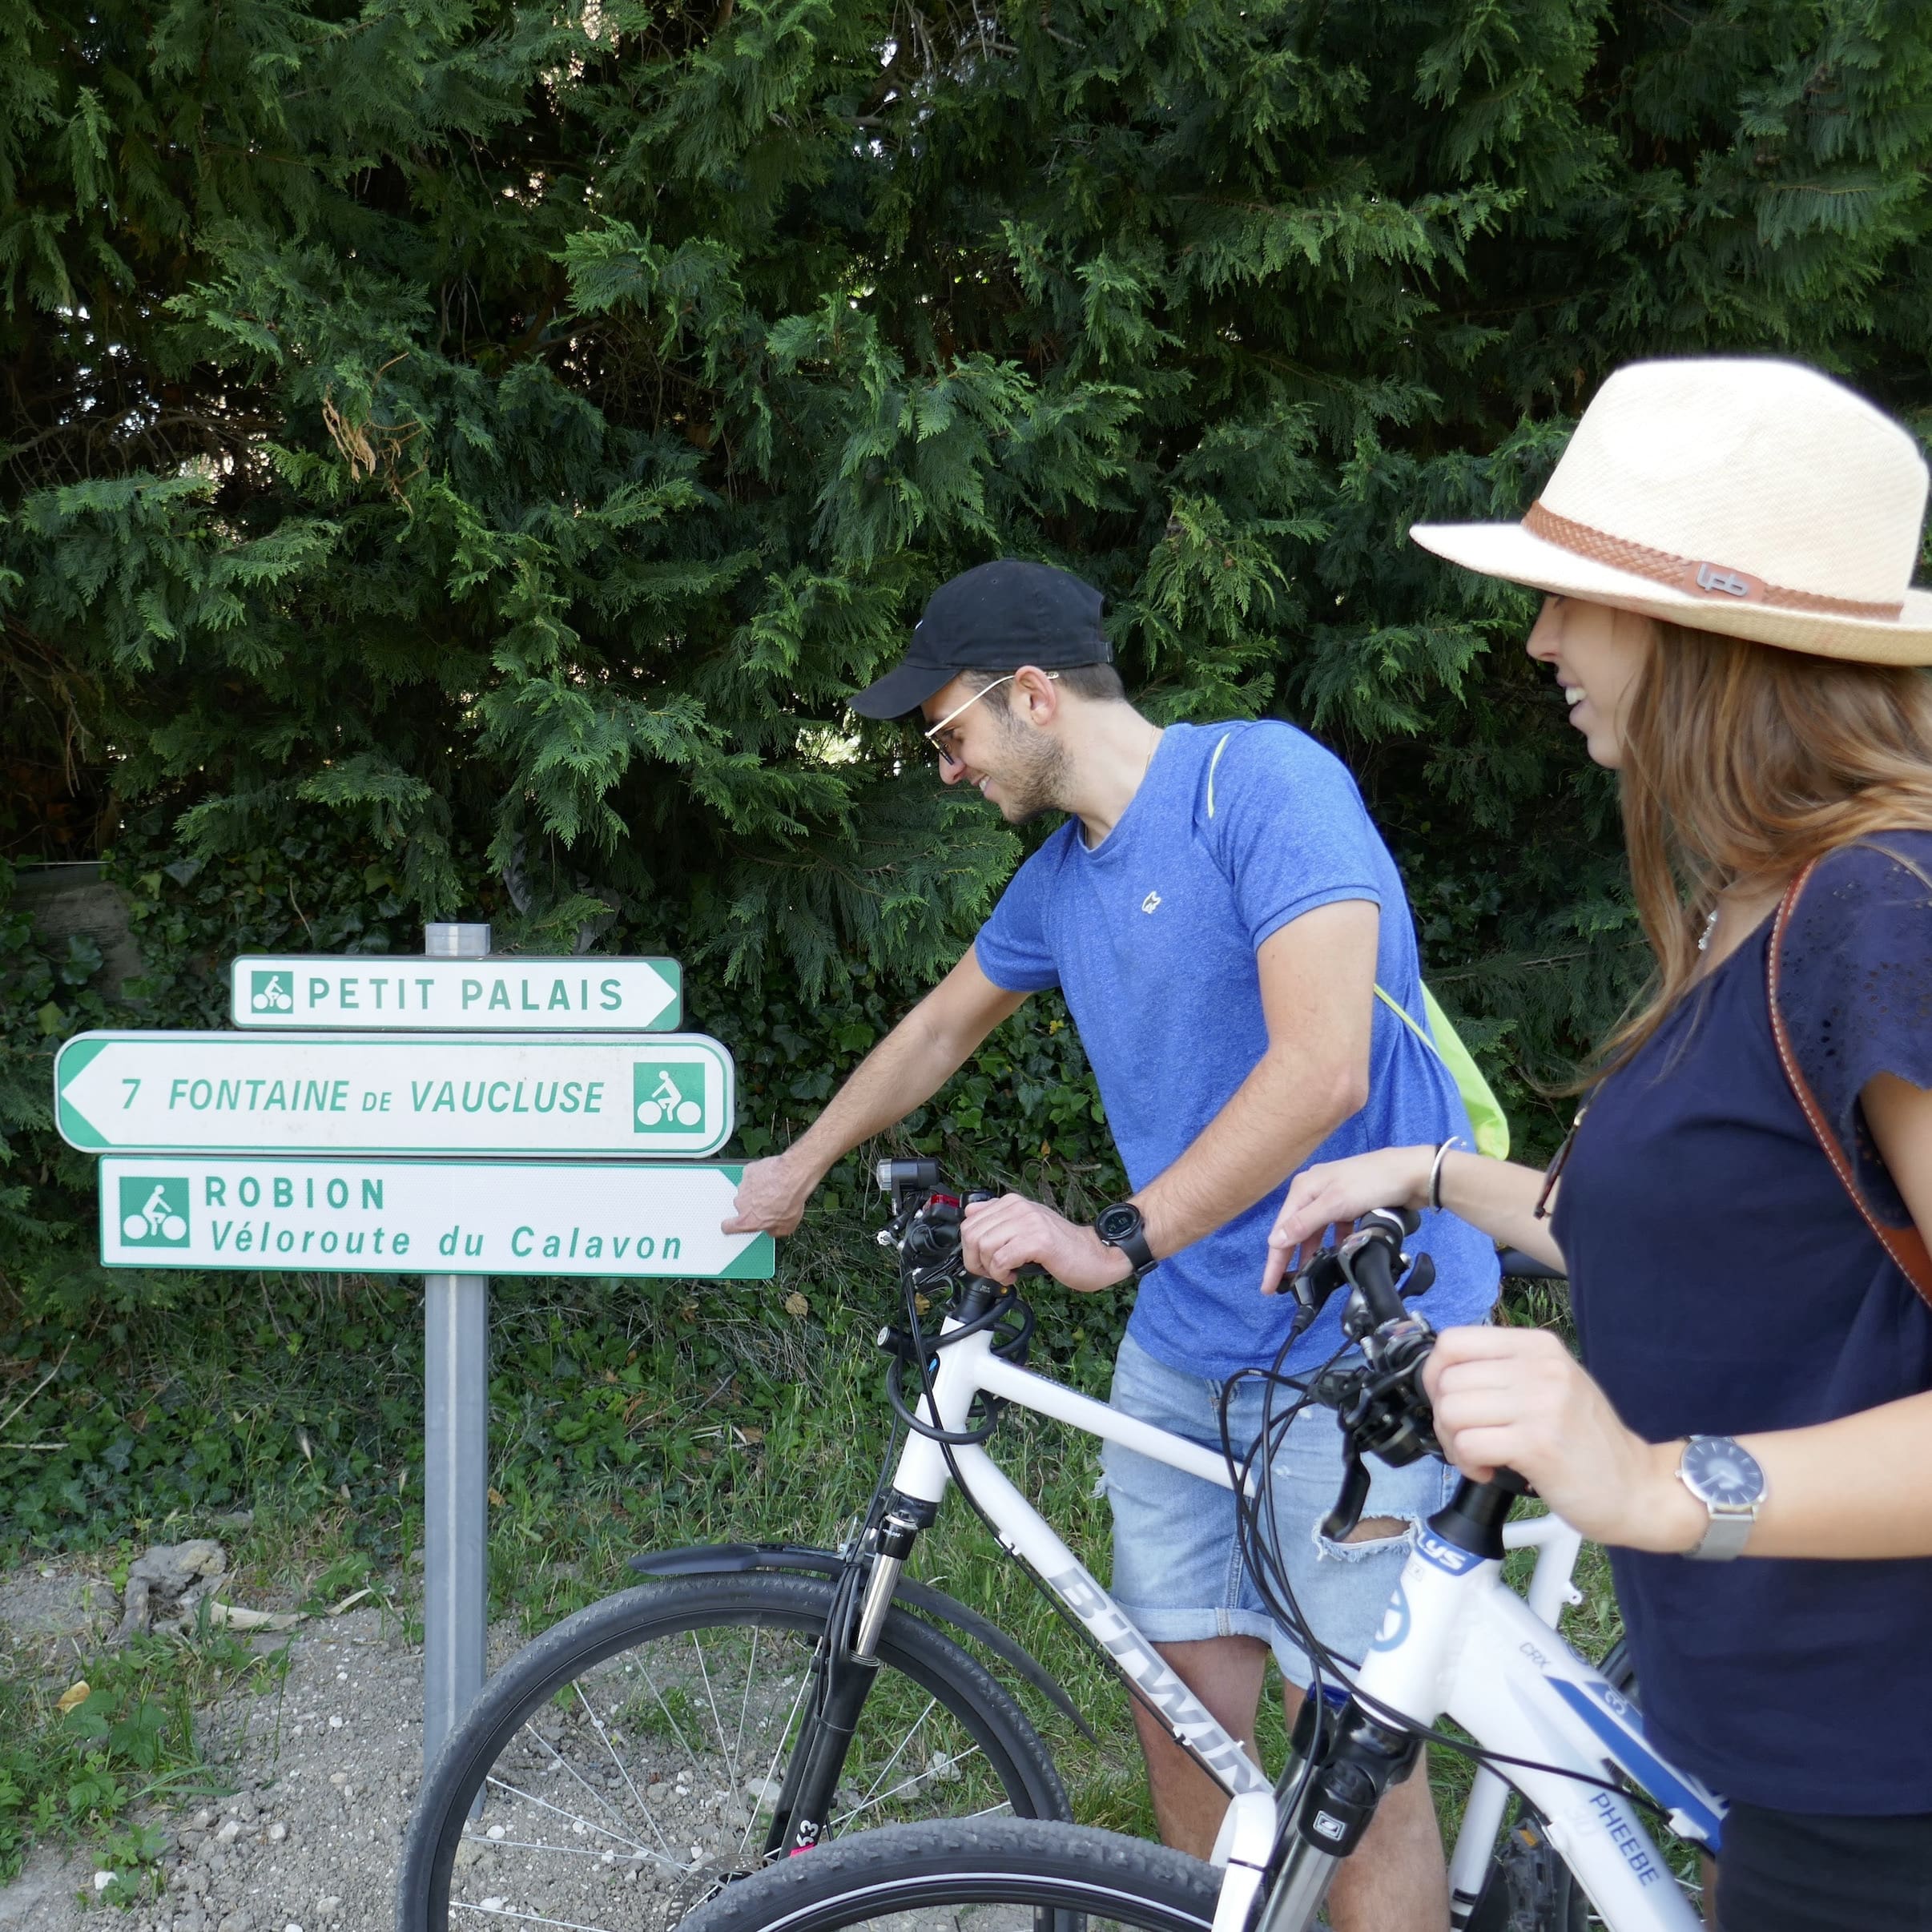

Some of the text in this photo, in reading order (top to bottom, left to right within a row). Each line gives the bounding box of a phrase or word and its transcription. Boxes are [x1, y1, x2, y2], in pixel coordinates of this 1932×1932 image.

[308, 976, 625, 1012] PETIT PALAIS
[121, 1077, 143, 1111] 7
[168, 1077, 351, 1113] FONTAINE
[410, 1079, 605, 1115] VAUCLUSE
[204, 1174, 386, 1212] ROBION
[211, 1218, 683, 1262] Véloroute du Calavon
[1588, 1792, 1660, 1887] PHEEBE
